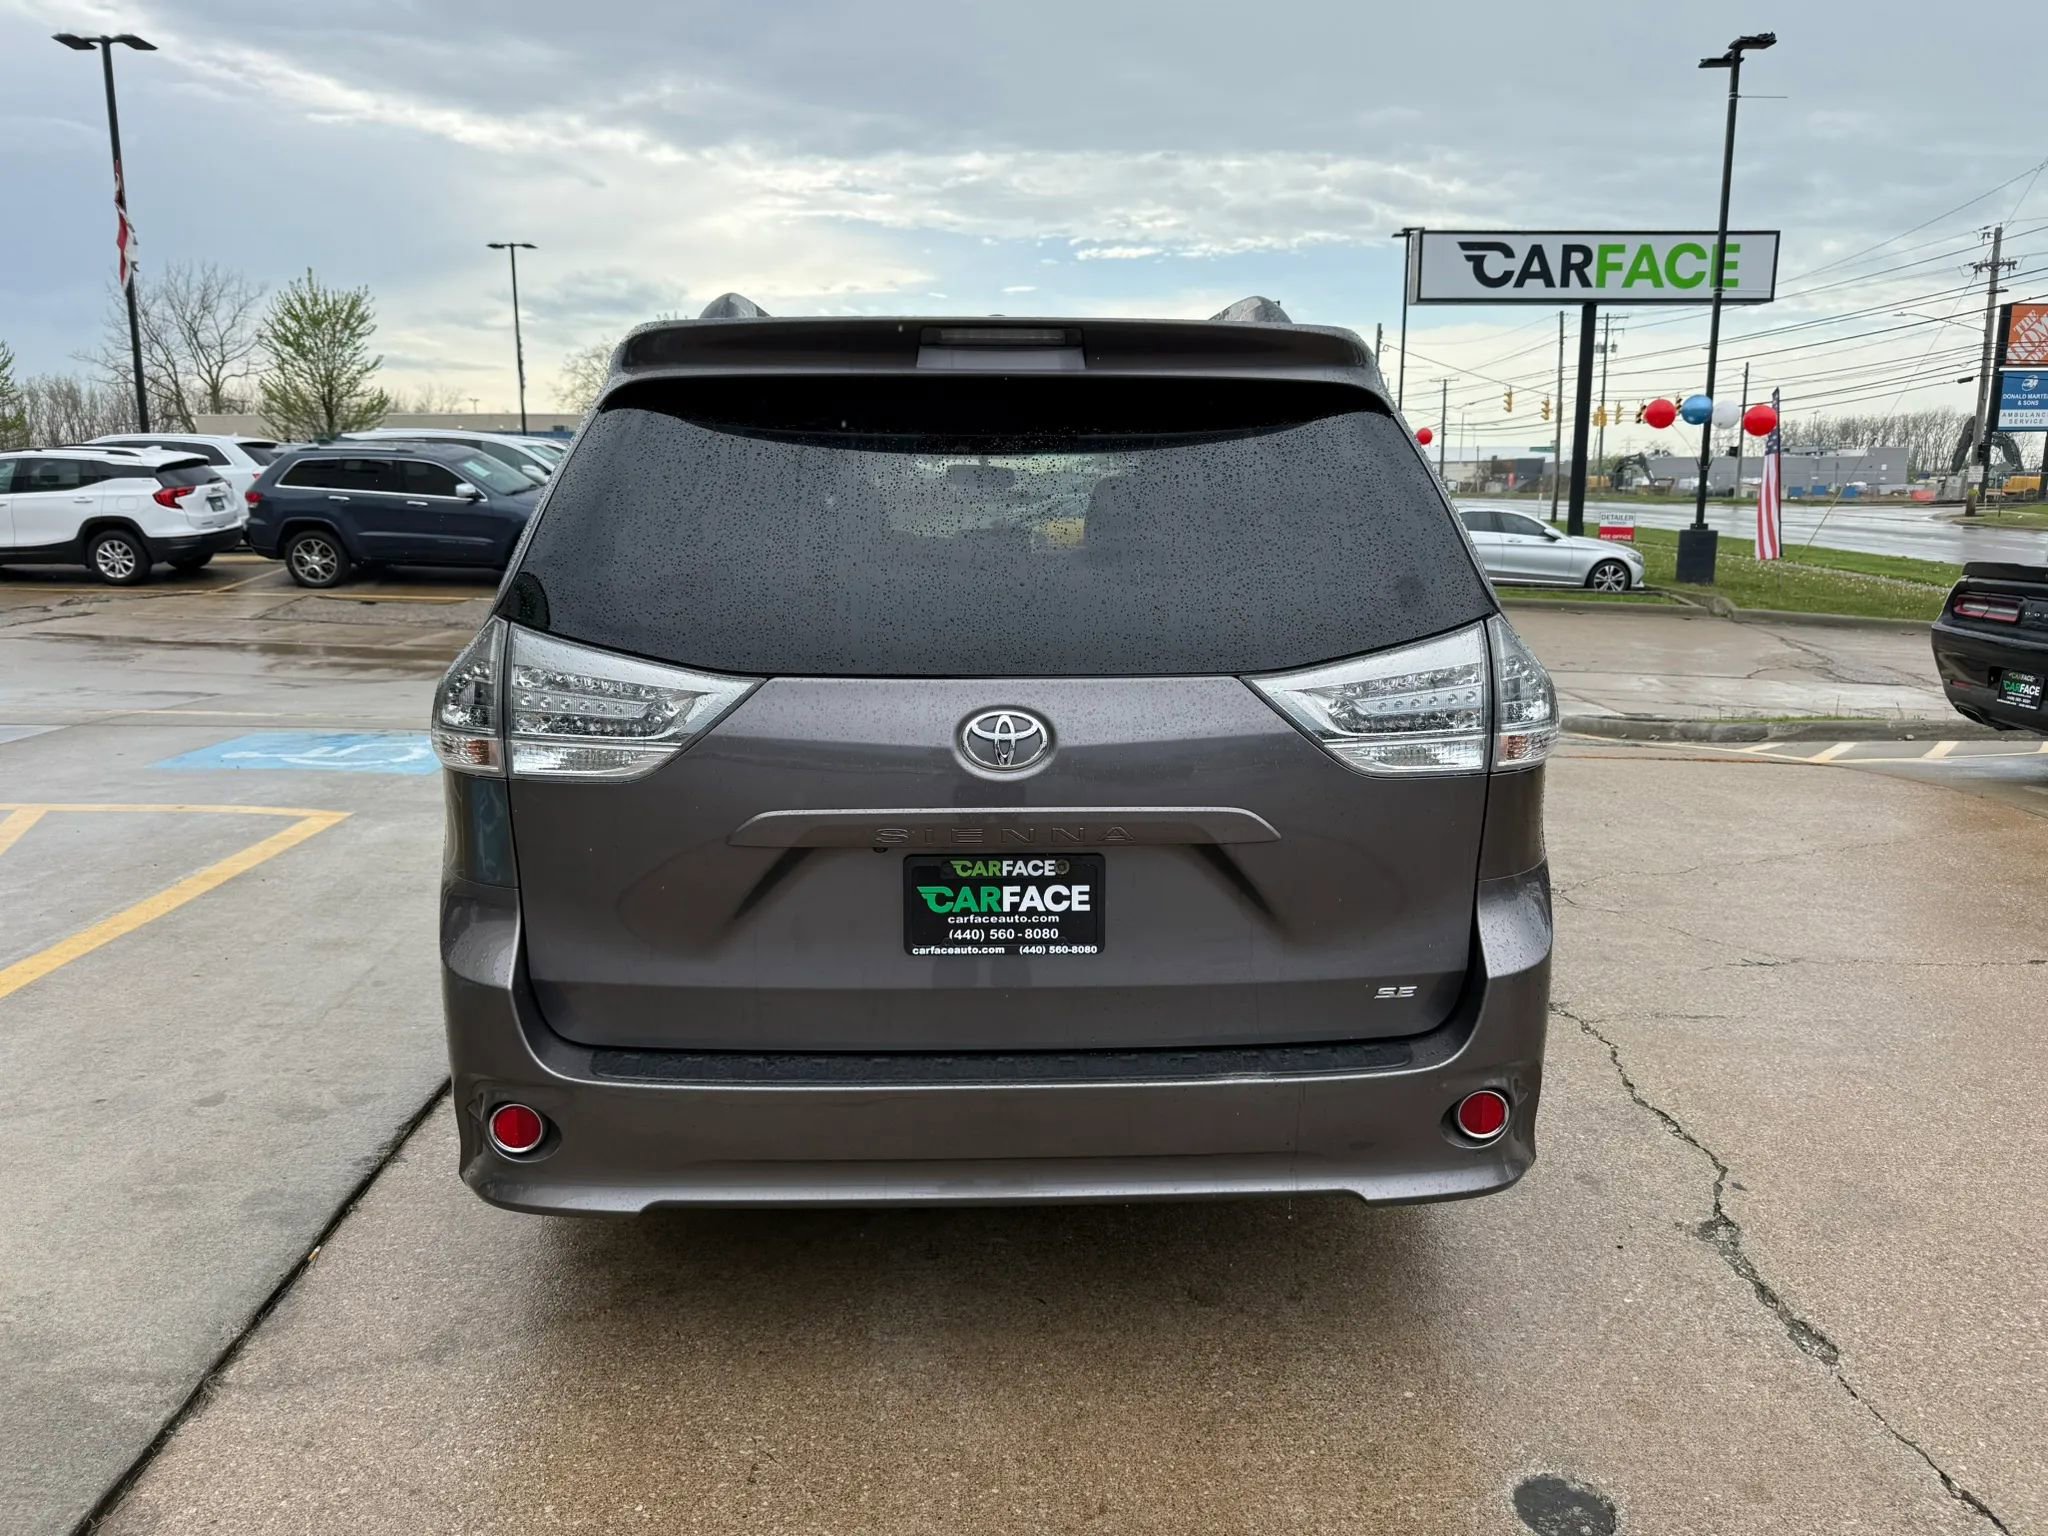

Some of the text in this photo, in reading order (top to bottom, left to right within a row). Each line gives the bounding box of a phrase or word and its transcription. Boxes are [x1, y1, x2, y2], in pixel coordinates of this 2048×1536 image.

[1457, 241, 1741, 289] CARFACE
[2013, 308, 2038, 335] THE
[2003, 680, 2040, 696] CARFACE
[874, 826, 1136, 845] SIENNA
[950, 859, 1056, 877] CARFACE
[916, 884, 1091, 913] CARFACE
[947, 914, 1060, 924] carfaceauto.com
[949, 929, 985, 942] (440)
[912, 945, 1098, 955] carfaceauto.com (440) 560-8080
[1373, 985, 1418, 999] SE
